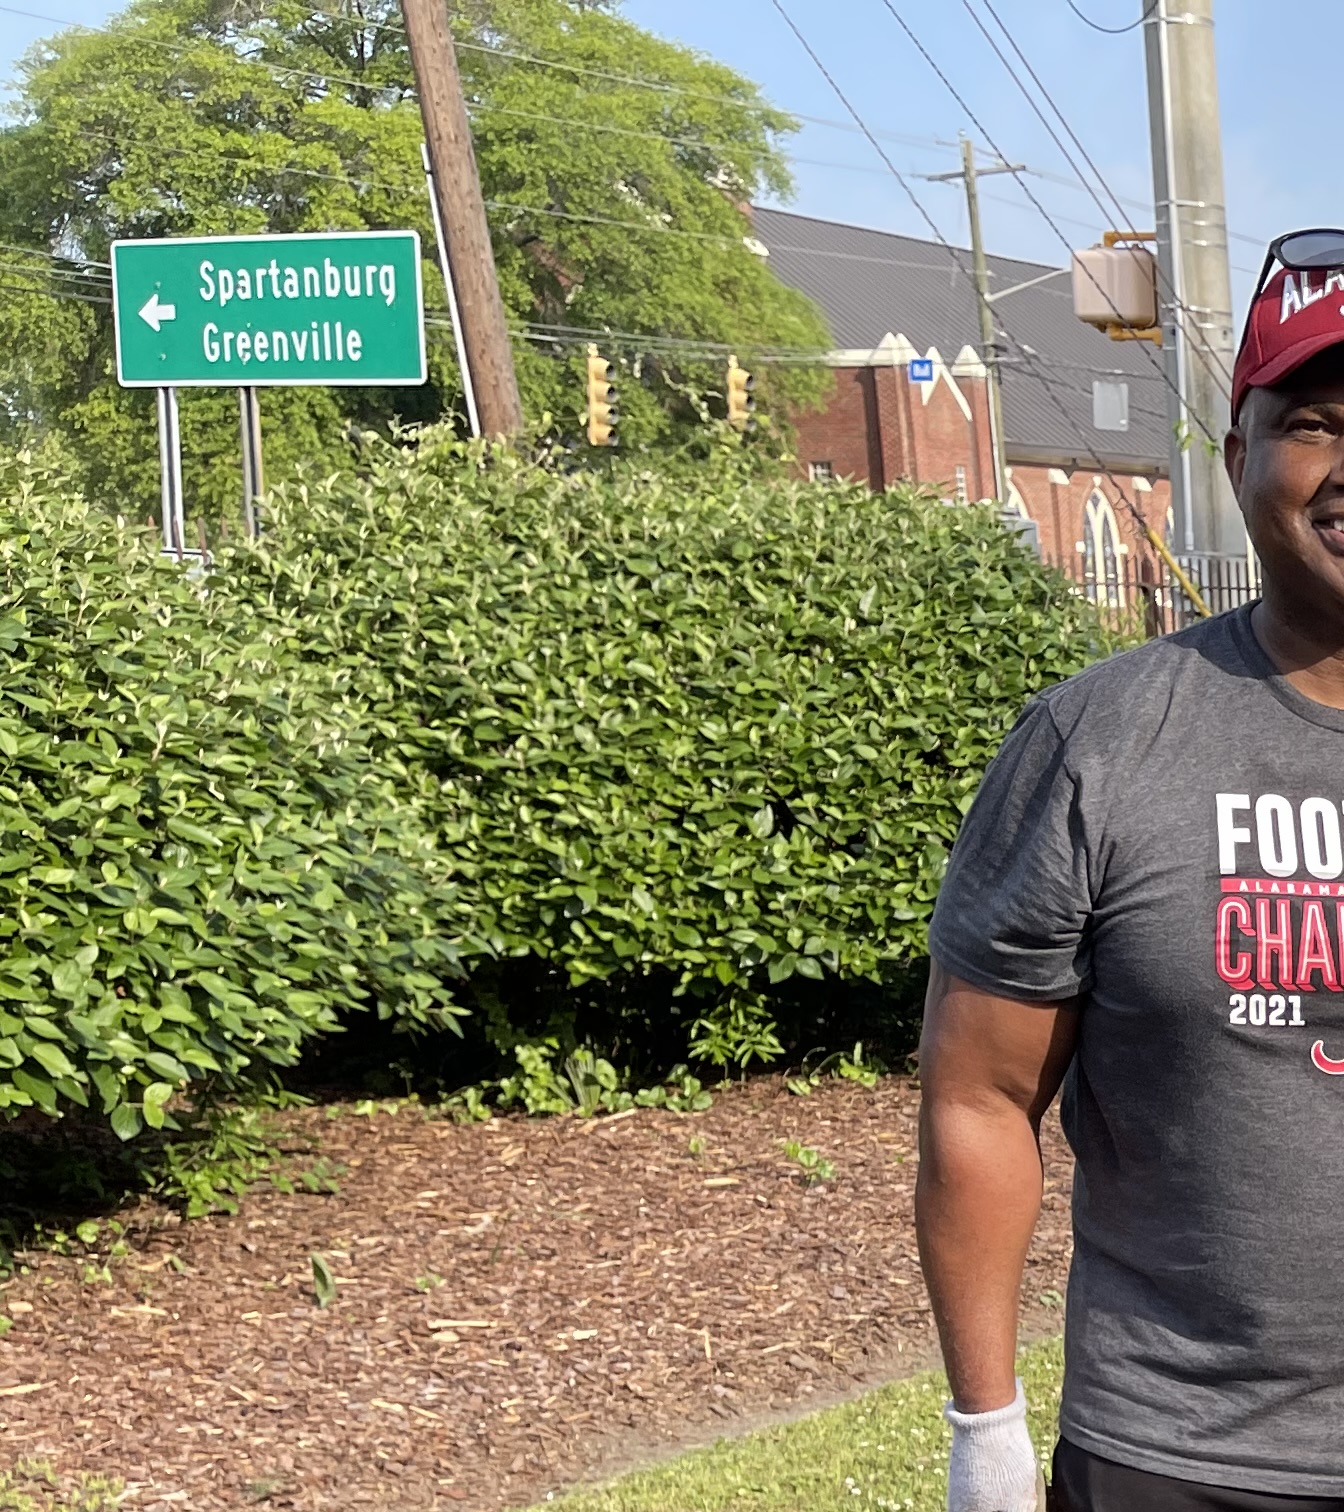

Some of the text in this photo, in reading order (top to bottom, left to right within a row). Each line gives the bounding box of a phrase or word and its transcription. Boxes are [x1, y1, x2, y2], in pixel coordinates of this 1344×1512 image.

[199, 257, 396, 307] Spartanburg
[203, 321, 362, 363] Greenville
[1228, 994, 1306, 1027] 2021
